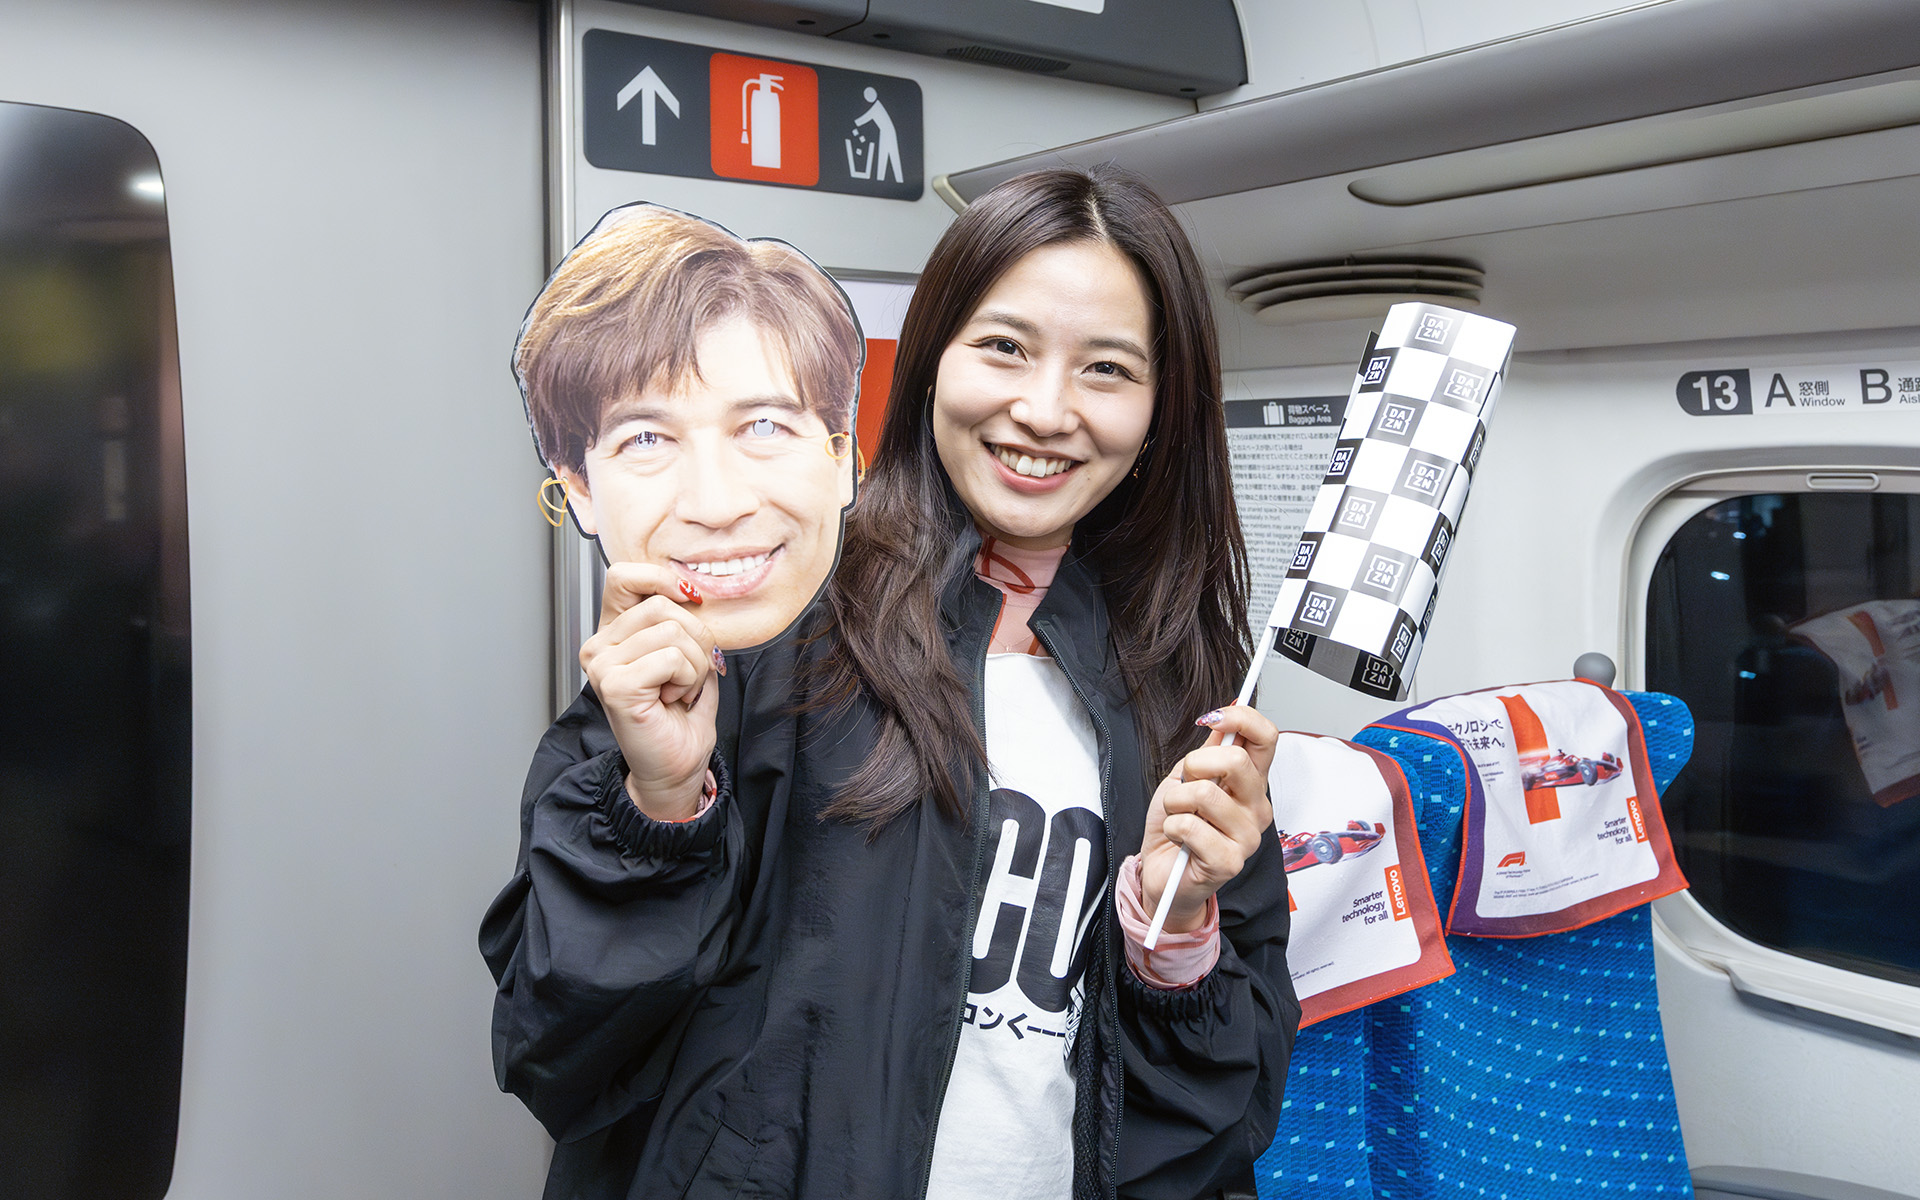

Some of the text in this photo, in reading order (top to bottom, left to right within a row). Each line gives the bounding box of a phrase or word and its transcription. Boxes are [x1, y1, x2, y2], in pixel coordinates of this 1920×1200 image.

[1692, 375, 1739, 411] 13
[1765, 372, 1796, 408] A
[1799, 380, 1829, 396] 窓側
[1860, 368, 1893, 405] B
[1287, 404, 1330, 415] 荷物スペース
[1799, 397, 1846, 407] Window
[1288, 415, 1332, 425] Baggage Area
[1604, 817, 1626, 828] Smarter
[1630, 800, 1645, 839] Lenovo
[1597, 826, 1629, 840] technology
[1353, 890, 1383, 908] Smarter
[1390, 870, 1406, 916] Lenovo
[1342, 901, 1385, 923] technology
[1364, 910, 1388, 925] for all
